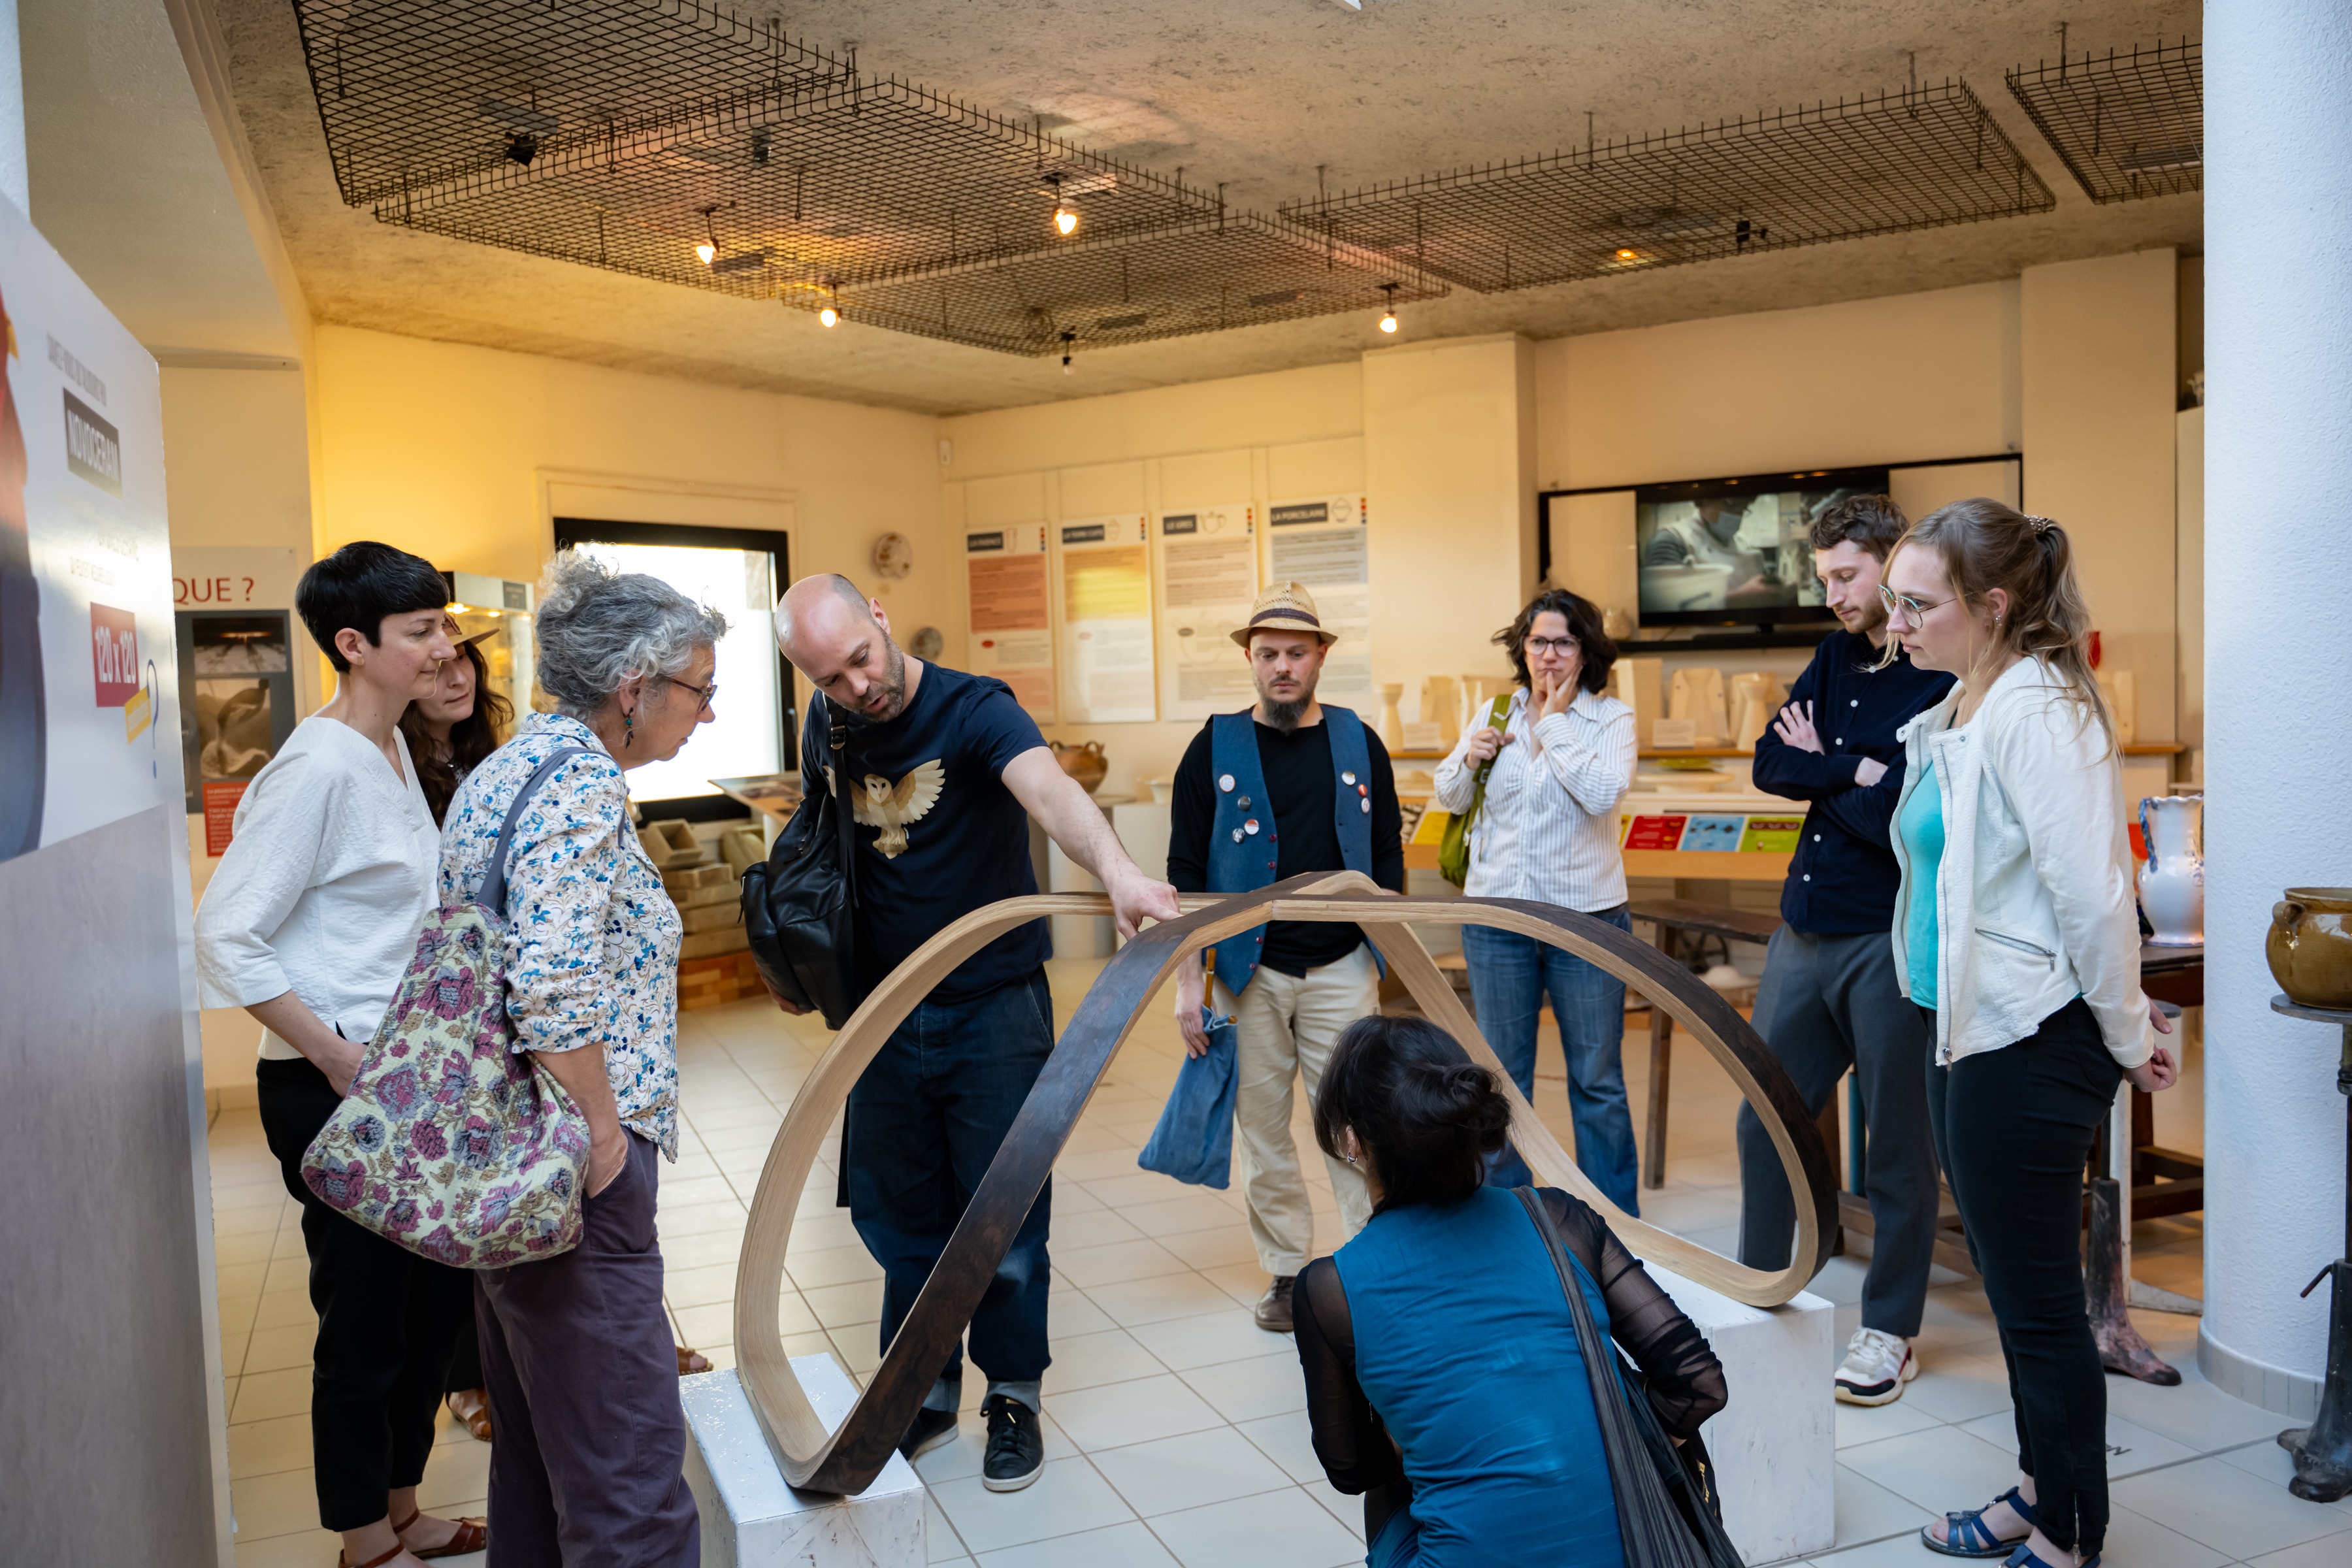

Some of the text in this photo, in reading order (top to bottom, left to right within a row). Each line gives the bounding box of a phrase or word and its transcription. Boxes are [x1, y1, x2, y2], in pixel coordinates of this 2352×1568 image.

[67, 408, 120, 484] NOVOCERAM
[242, 578, 255, 602] ?
[95, 625, 114, 683] 120
[120, 629, 137, 684] 120
